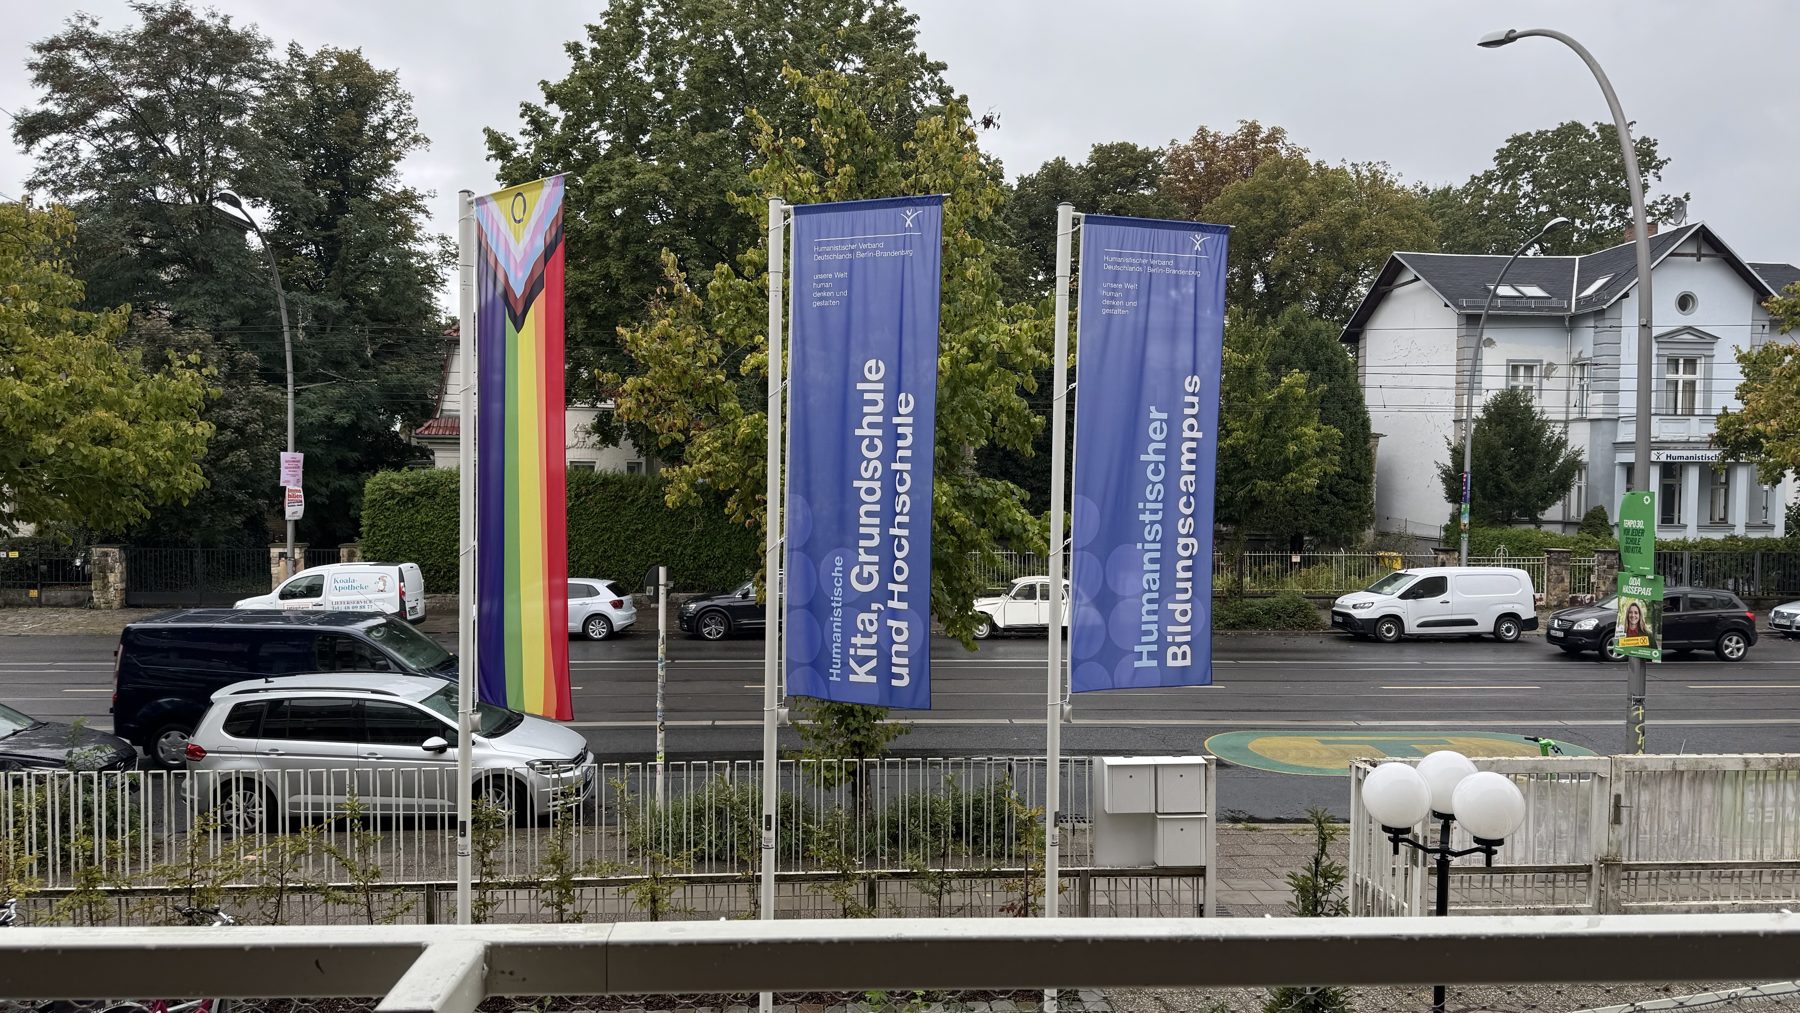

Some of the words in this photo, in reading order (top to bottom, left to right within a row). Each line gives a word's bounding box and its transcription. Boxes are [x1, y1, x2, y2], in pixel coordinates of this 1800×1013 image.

[813, 243, 857, 252] Humanistischer
[858, 241, 884, 250] Verband
[813, 253, 852, 261] Deutschlands
[856, 249, 913, 259] Berlin-Brandenburg
[1103, 255, 1148, 264] Humanistischer
[1149, 257, 1174, 266] Verband
[834, 271, 848, 279] Welt
[1103, 264, 1143, 272] Deutschlands
[1147, 266, 1201, 277] Berlin-Brandenburg
[812, 281, 833, 289] human
[1124, 282, 1138, 290] Welt
[836, 289, 848, 297] und
[812, 299, 840, 307] gestalten
[1102, 299, 1124, 307] denken
[1125, 299, 1138, 307] und
[1101, 307, 1129, 315] gestalten
[1665, 453, 1721, 461] Humanistisch
[850, 358, 885, 593] Grundschule
[886, 392, 915, 609] Hochschule
[1166, 374, 1203, 668] Bildungscampus
[1133, 405, 1168, 668] Humanistischer
[332, 583, 369, 592] Apotheke
[828, 555, 843, 682] Humanistische
[849, 602, 884, 684] Kita,
[886, 619, 910, 687] und
